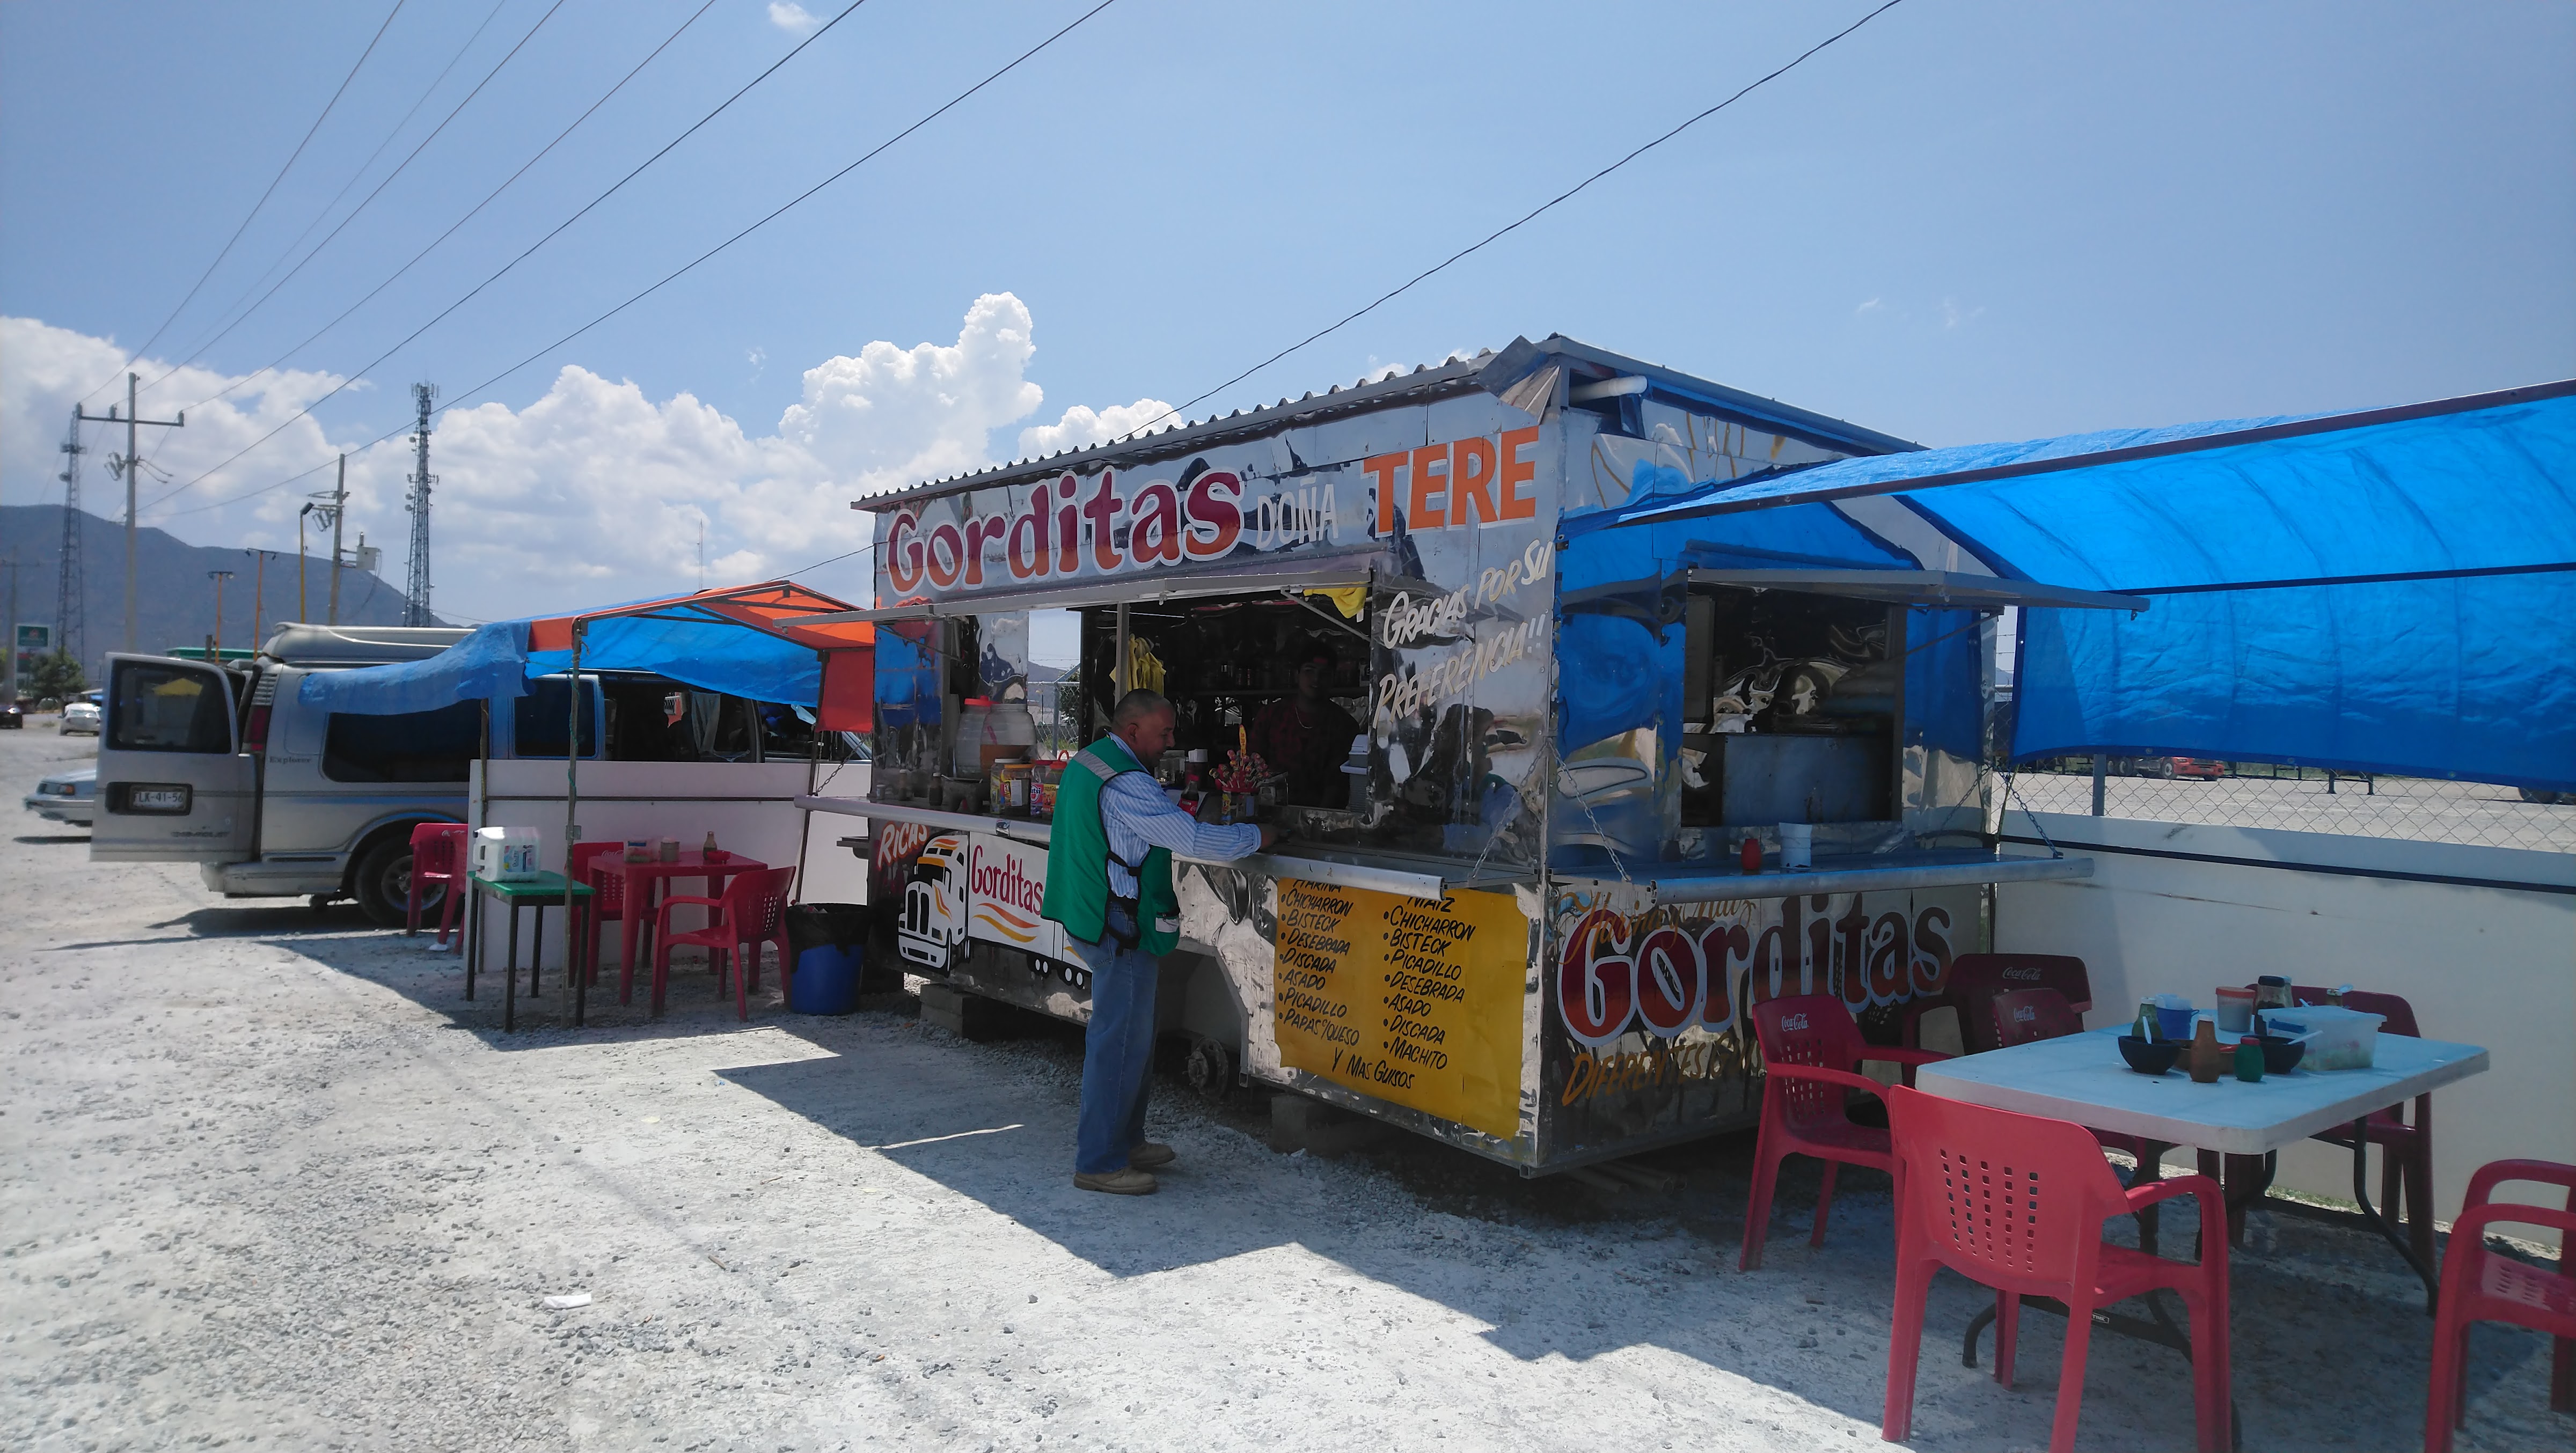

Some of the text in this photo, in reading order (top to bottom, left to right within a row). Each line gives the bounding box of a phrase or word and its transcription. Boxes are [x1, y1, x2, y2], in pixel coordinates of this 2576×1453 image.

[887, 425, 1539, 597] Gorditas DOÑA TERE
[1383, 539, 1553, 649] GRACIAS POR SU
[1372, 614, 1546, 729] PREFERENCIA!!
[877, 822, 928, 869] RICAS
[971, 845, 1044, 915] Gorditas
[1286, 888, 1354, 917] CHICHARRON
[1287, 909, 1341, 933] BISTECK
[1390, 905, 1476, 942] CHICHARRON
[1287, 928, 1351, 956] DESEBRADA
[1389, 928, 1452, 957] BISTECK
[1282, 948, 1337, 974] DISCADA
[1390, 949, 1462, 981] PICADILLO
[1558, 893, 1953, 1048] Gorditas
[1283, 968, 1326, 990] ASADO
[1389, 971, 1466, 1003] DESEBRADA
[1283, 987, 1348, 1018] PICADILLO
[1388, 993, 1431, 1017] ASADO
[1283, 1008, 1321, 1035] PAPAS
[1389, 1015, 1446, 1045] DISCADA
[1781, 1012, 1809, 1032] Coca-Cola
[1331, 1047, 1415, 1089] Y MAS GUISOS
[1389, 1036, 1448, 1070] MACHITO
[1561, 1041, 1708, 1107] DIFERENTES
